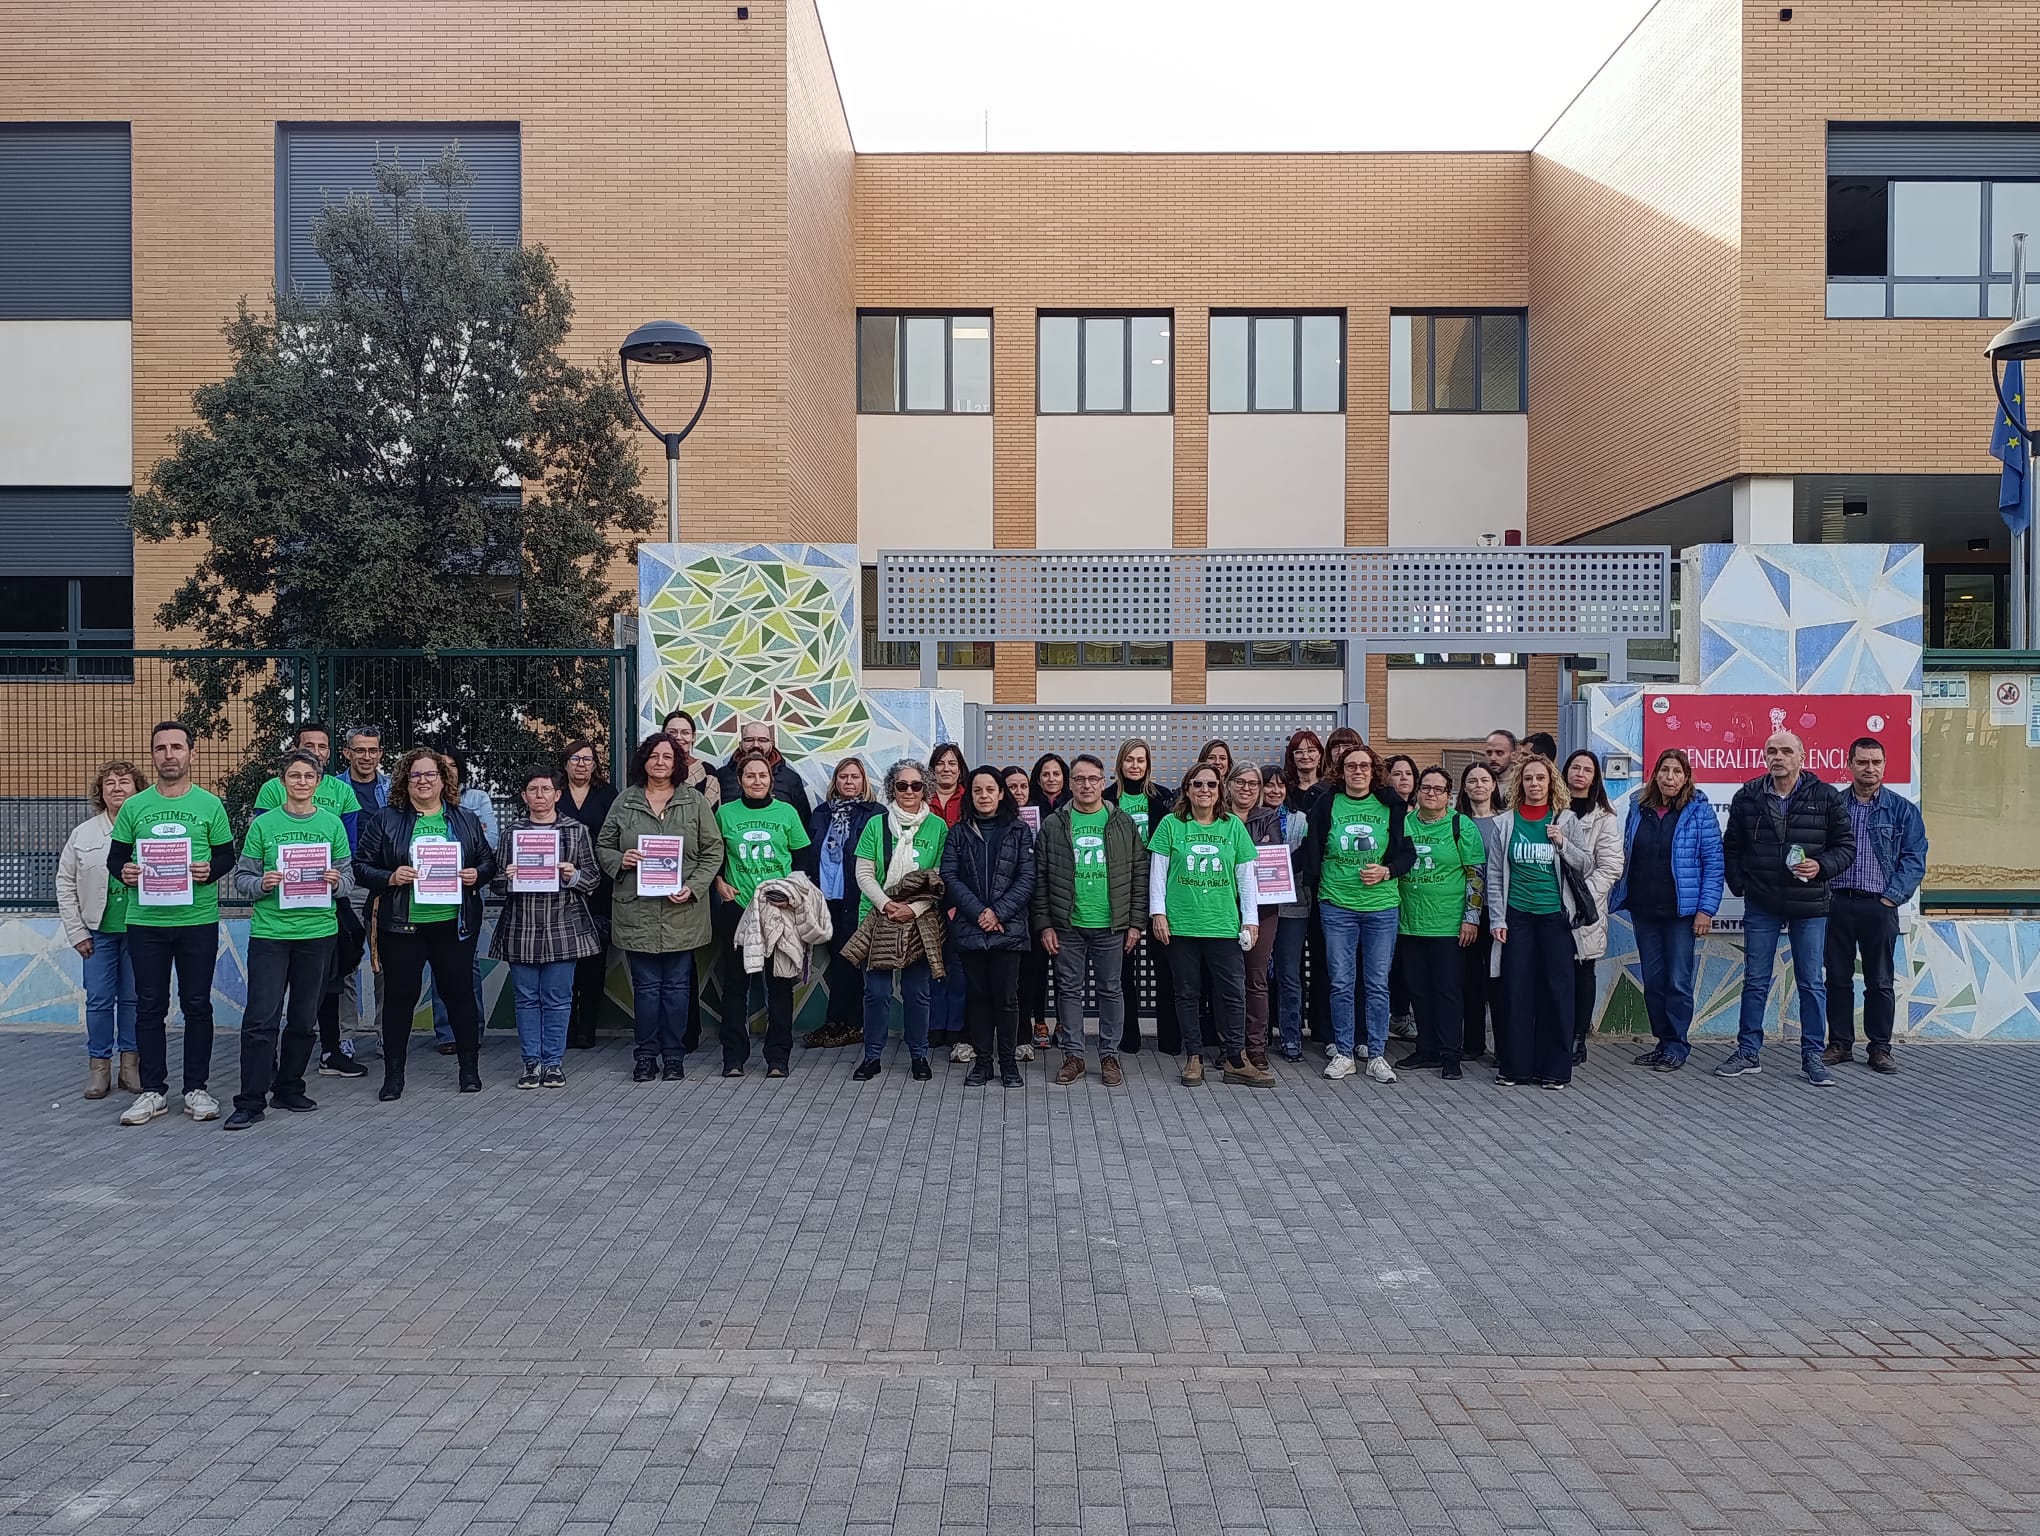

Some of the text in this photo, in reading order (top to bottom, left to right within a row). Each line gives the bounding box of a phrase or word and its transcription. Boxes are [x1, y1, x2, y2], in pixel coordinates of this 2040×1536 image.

[1680, 748, 1768, 769] ENERALITA
[144, 810, 198, 825] ESTIMEM
[518, 834, 525, 843] 7
[643, 839, 650, 848] 7
[142, 844, 150, 853] 7
[418, 847, 425, 855] 7
[1513, 842, 1523, 860] LA
[284, 850, 291, 859] 7
